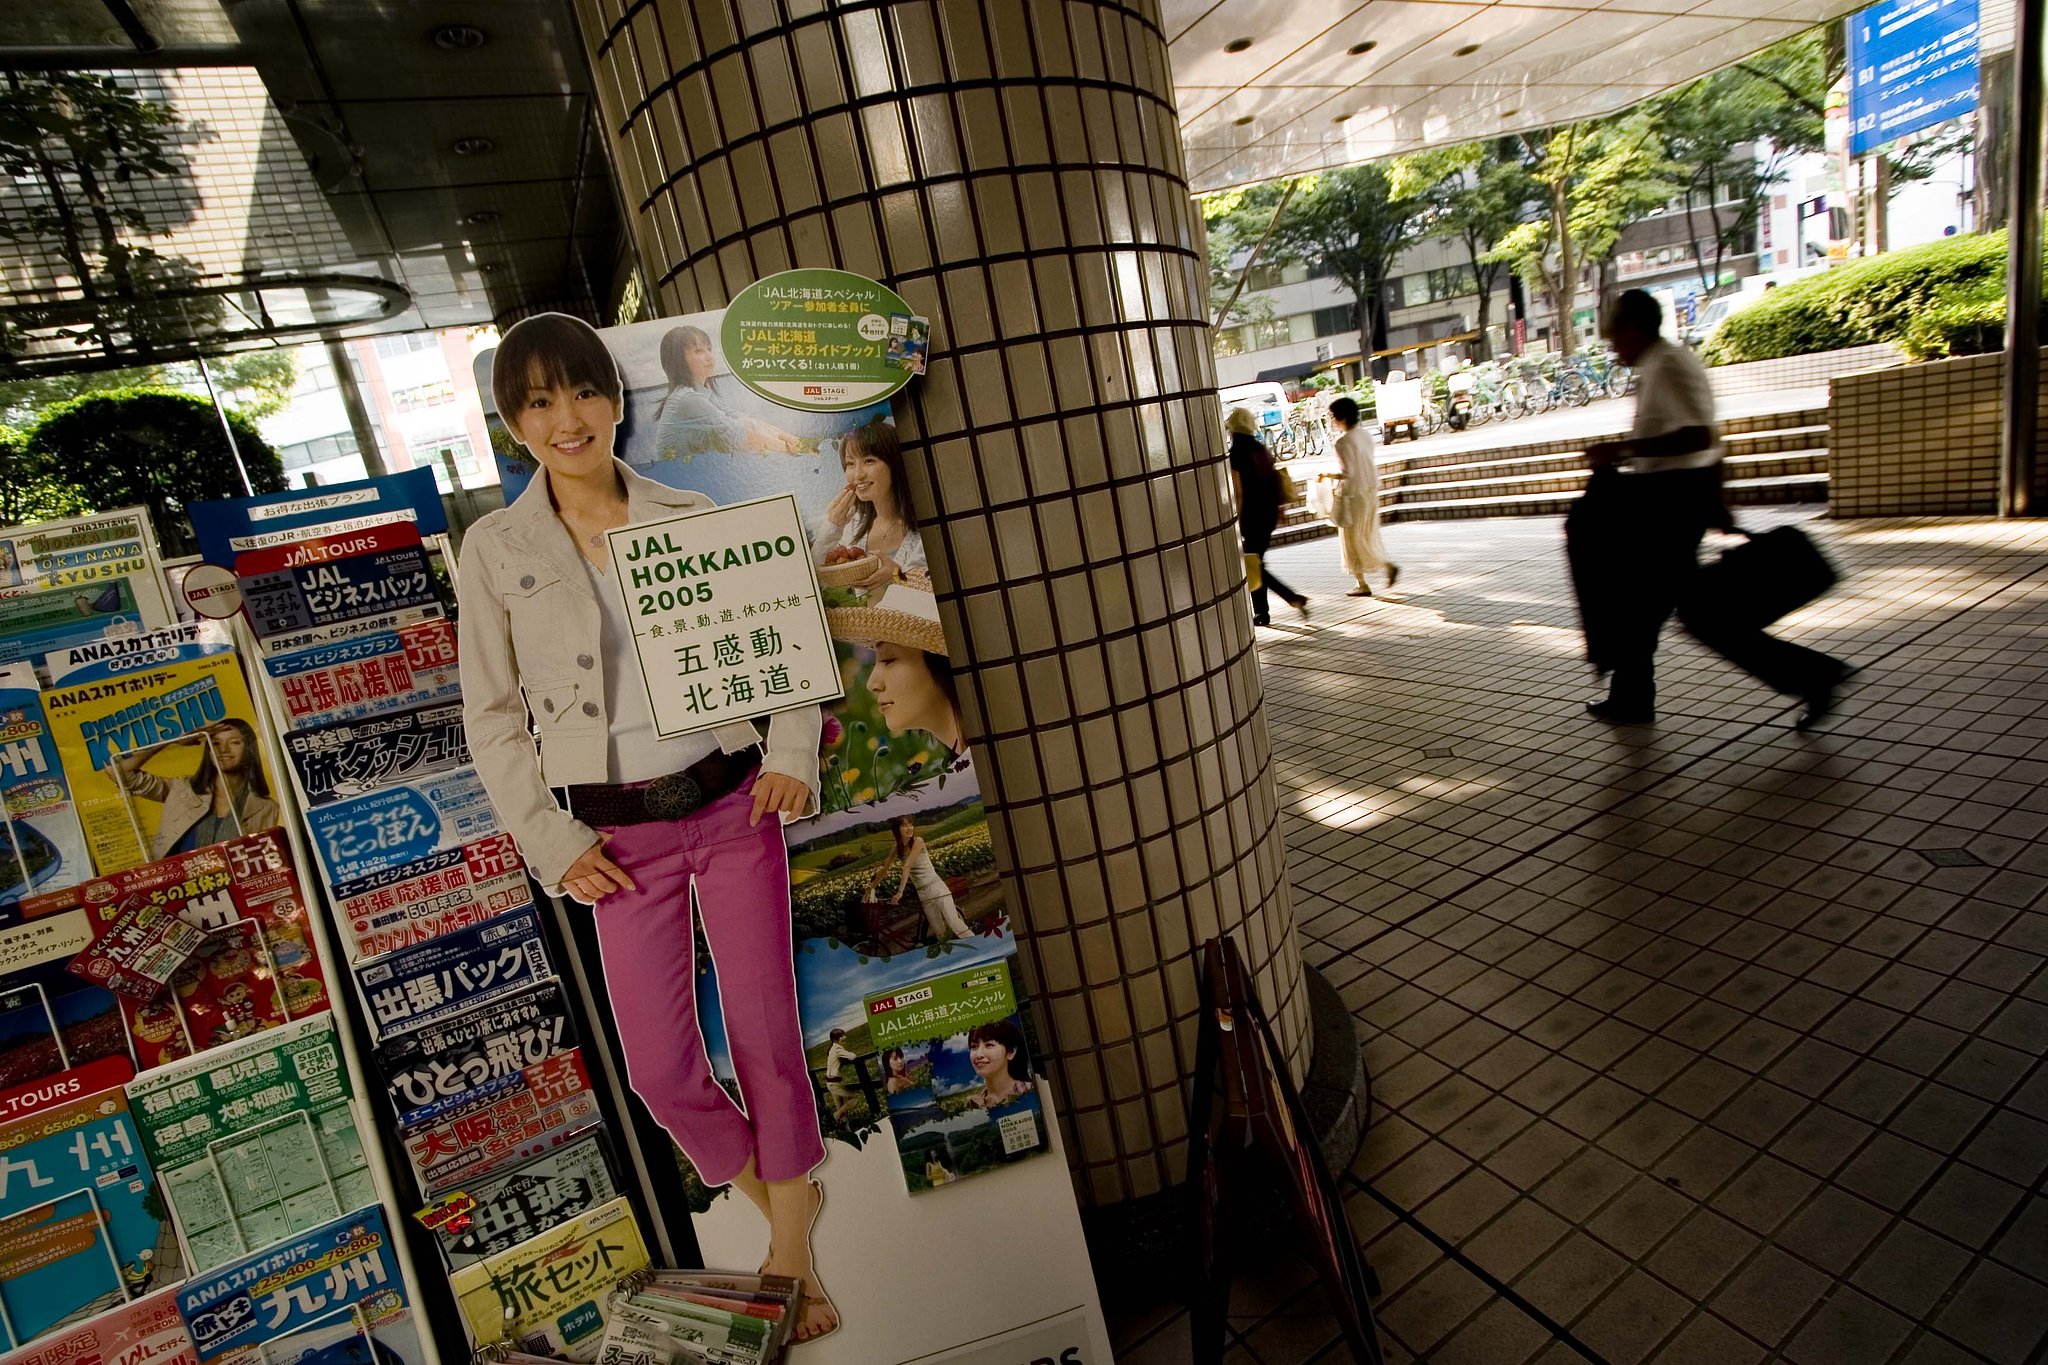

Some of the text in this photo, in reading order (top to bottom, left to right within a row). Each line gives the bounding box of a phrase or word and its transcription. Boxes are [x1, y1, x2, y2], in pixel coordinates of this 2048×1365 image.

[1862, 26, 1870, 43] 1
[1858, 65, 1874, 87] B1
[1857, 113, 1876, 133] B2
[769, 301, 871, 313] ツアー参加者全員に
[740, 329, 817, 344] 「JAL北海道
[805, 387, 821, 395] JAL
[263, 491, 366, 517] お得な出張プラン
[38, 524, 137, 550] HOKKAIDO
[625, 532, 683, 562] JAL
[42, 544, 141, 570] OKINAWA
[50, 558, 146, 587] KYUSHU
[630, 535, 796, 589] HOKKAIDO
[190, 583, 237, 600] JAL STAGE
[301, 565, 351, 591] JAL
[306, 571, 428, 614] ビジネスパック
[250, 590, 297, 609] フライト
[255, 601, 300, 619] &ホテル
[638, 581, 714, 616] 2005
[271, 615, 398, 651] 日本全国へ、ビジネスの旅を
[405, 626, 450, 650] エース
[274, 637, 400, 674] エースビジネスプラン
[410, 643, 456, 667] JTB
[674, 625, 802, 677] 五感動、
[49, 672, 177, 710] ANAスカイホリデー
[282, 655, 415, 718] 出張応援価
[683, 663, 811, 715] 北海道。
[80, 696, 161, 741] Dynamic
[85, 687, 228, 772] KYUSHU
[291, 726, 352, 753] 日本全国
[321, 804, 417, 838] フリータイム
[228, 836, 280, 863] エース
[329, 814, 437, 862] にっぽん
[467, 834, 513, 862] エース
[236, 852, 284, 879] JTB
[338, 850, 462, 898] エースビジネスプラン
[472, 851, 520, 882] JTB
[277, 903, 295, 914] 35
[344, 866, 468, 920] 出張応援価
[408, 888, 473, 919] 50周年記念
[106, 926, 148, 963] 九州
[357, 903, 487, 957] ワシントンホテル
[371, 946, 523, 1025] 出張パック
[873, 989, 930, 1013] JAL STAGE
[422, 1004, 540, 1055] 出張&ひとり旅におすすめ
[878, 991, 1006, 1037] JAL北海道スペシャル
[297, 1046, 330, 1062] 5日前
[306, 1062, 331, 1075] OK!
[209, 1052, 281, 1089] 鹿児島
[531, 1061, 578, 1089] エース
[142, 1080, 201, 1115] 福岡
[221, 1081, 300, 1124] 大阪・和歌山
[409, 1073, 521, 1121] エースビジネスプラン
[493, 1091, 531, 1116] 京都
[538, 1076, 582, 1103] JTB
[408, 1083, 525, 1137] エースビジネスプラン
[499, 1106, 537, 1129] 神戸
[154, 1114, 214, 1148] 徳島
[411, 1112, 498, 1165] 大阪
[485, 1123, 543, 1154] 名古屋
[500, 1177, 538, 1198] JRで行く
[475, 1175, 584, 1244] 出張
[485, 1201, 584, 1255] おまかせ
[186, 1241, 320, 1311] ANAスカイホリデー
[261, 1249, 388, 1330] 九州
[489, 1238, 625, 1319] 旅セット
[562, 1309, 596, 1333] ホテル
